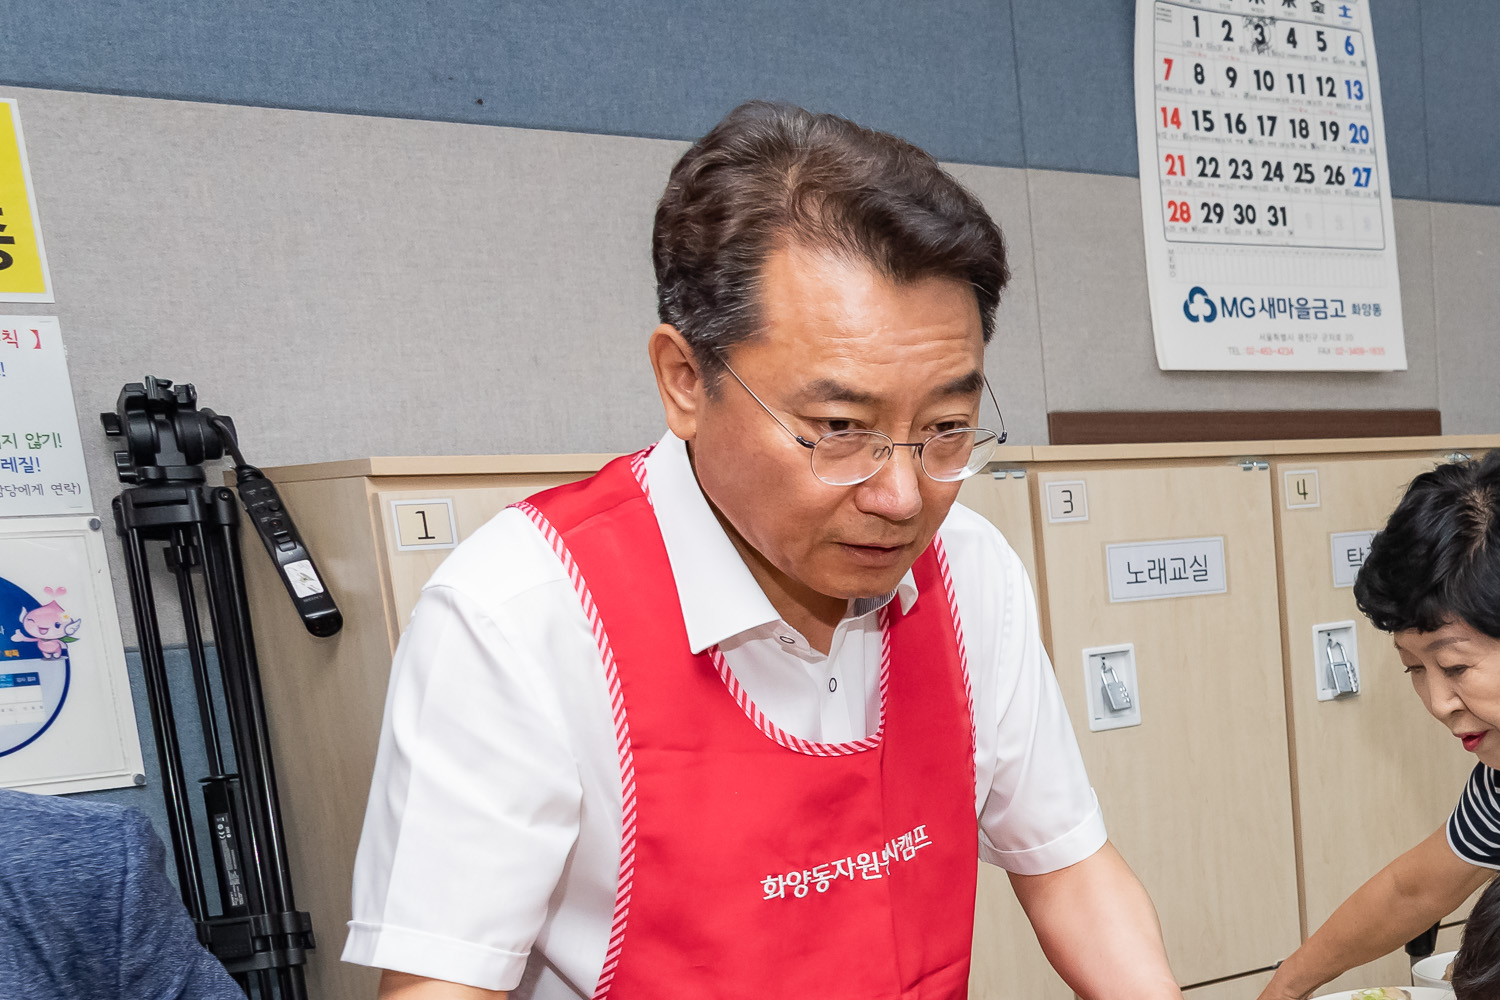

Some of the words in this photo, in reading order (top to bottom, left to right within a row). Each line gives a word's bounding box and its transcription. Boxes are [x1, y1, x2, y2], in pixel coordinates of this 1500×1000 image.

[1310, 1, 1325, 15] 金
[1338, 5, 1354, 19] 土
[1193, 16, 1199, 37] 1
[1222, 20, 1233, 41] 2
[1254, 23, 1266, 45] 3
[1287, 28, 1297, 48] 4
[1316, 31, 1327, 52] 5
[1345, 36, 1354, 56] 6
[1164, 58, 1173, 80] 7
[1194, 63, 1205, 84] 8
[1226, 67, 1237, 88] 9
[1254, 70, 1274, 91] 10
[1287, 74, 1305, 94] 11
[1316, 77, 1336, 97] 12
[1345, 80, 1363, 100] 13
[1161, 107, 1181, 129] 14
[1192, 110, 1214, 132] 15
[1225, 113, 1246, 134] 16
[1257, 115, 1277, 136] 17
[1290, 119, 1309, 139] 18
[1320, 121, 1339, 141] 19
[1349, 123, 1369, 144] 20
[1166, 154, 1185, 176] 21
[1197, 156, 1220, 178] 22
[1229, 158, 1253, 180] 23
[1262, 161, 1284, 181] 24
[1293, 163, 1315, 184] 25
[1324, 165, 1345, 185] 26
[1353, 167, 1371, 187] 27
[1168, 201, 1191, 222] 28
[1201, 202, 1224, 223] 29
[1234, 204, 1256, 224] 30
[1268, 206, 1286, 226] 31
[1220, 296, 1256, 319] MG
[1259, 297, 1347, 320] 새마을금고
[1351, 303, 1383, 317] 화양동
[0, 432, 18, 450] 지
[25, 432, 62, 450] 않기!
[51, 482, 82, 497] 연락)
[1061, 489, 1074, 514] 3
[1296, 478, 1309, 501] 4
[415, 510, 436, 540] 1
[1347, 546, 1372, 567] 탁
[1126, 554, 1209, 585] 노래교실
